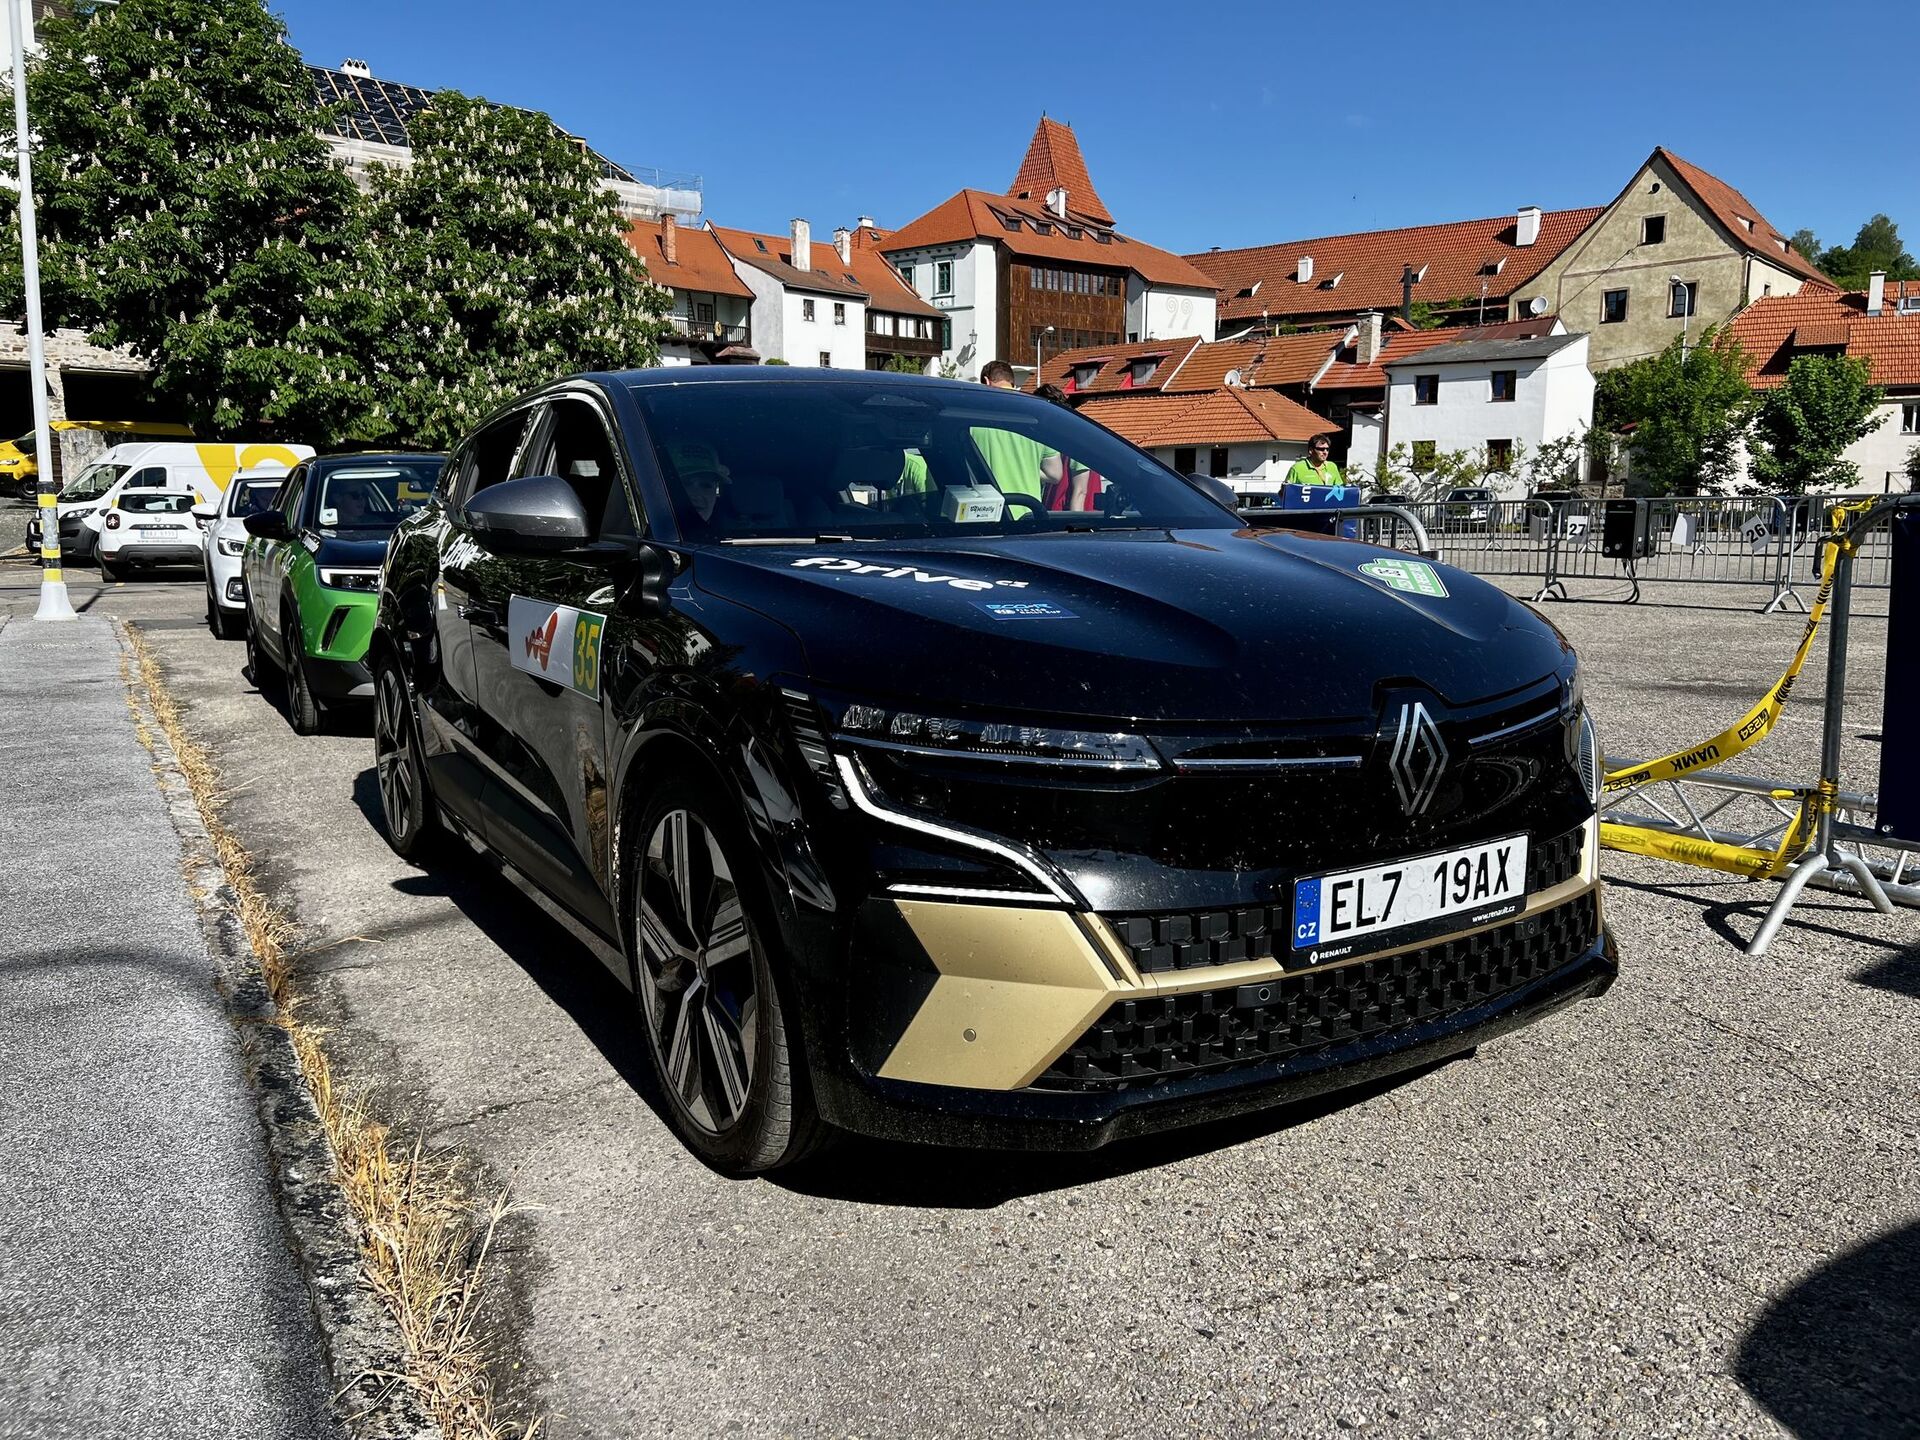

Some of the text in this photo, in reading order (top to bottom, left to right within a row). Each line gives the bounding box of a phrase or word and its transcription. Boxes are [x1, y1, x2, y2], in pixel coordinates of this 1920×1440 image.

[1569, 523, 1587, 536] 27
[1746, 523, 1766, 543] 26
[574, 621, 600, 691] 35
[1670, 745, 1720, 772] UAMK
[1297, 846, 1511, 939] CZ EL7 19AX
[1472, 905, 1516, 922] www.renault.cz
[1319, 946, 1352, 960] RENAULT
